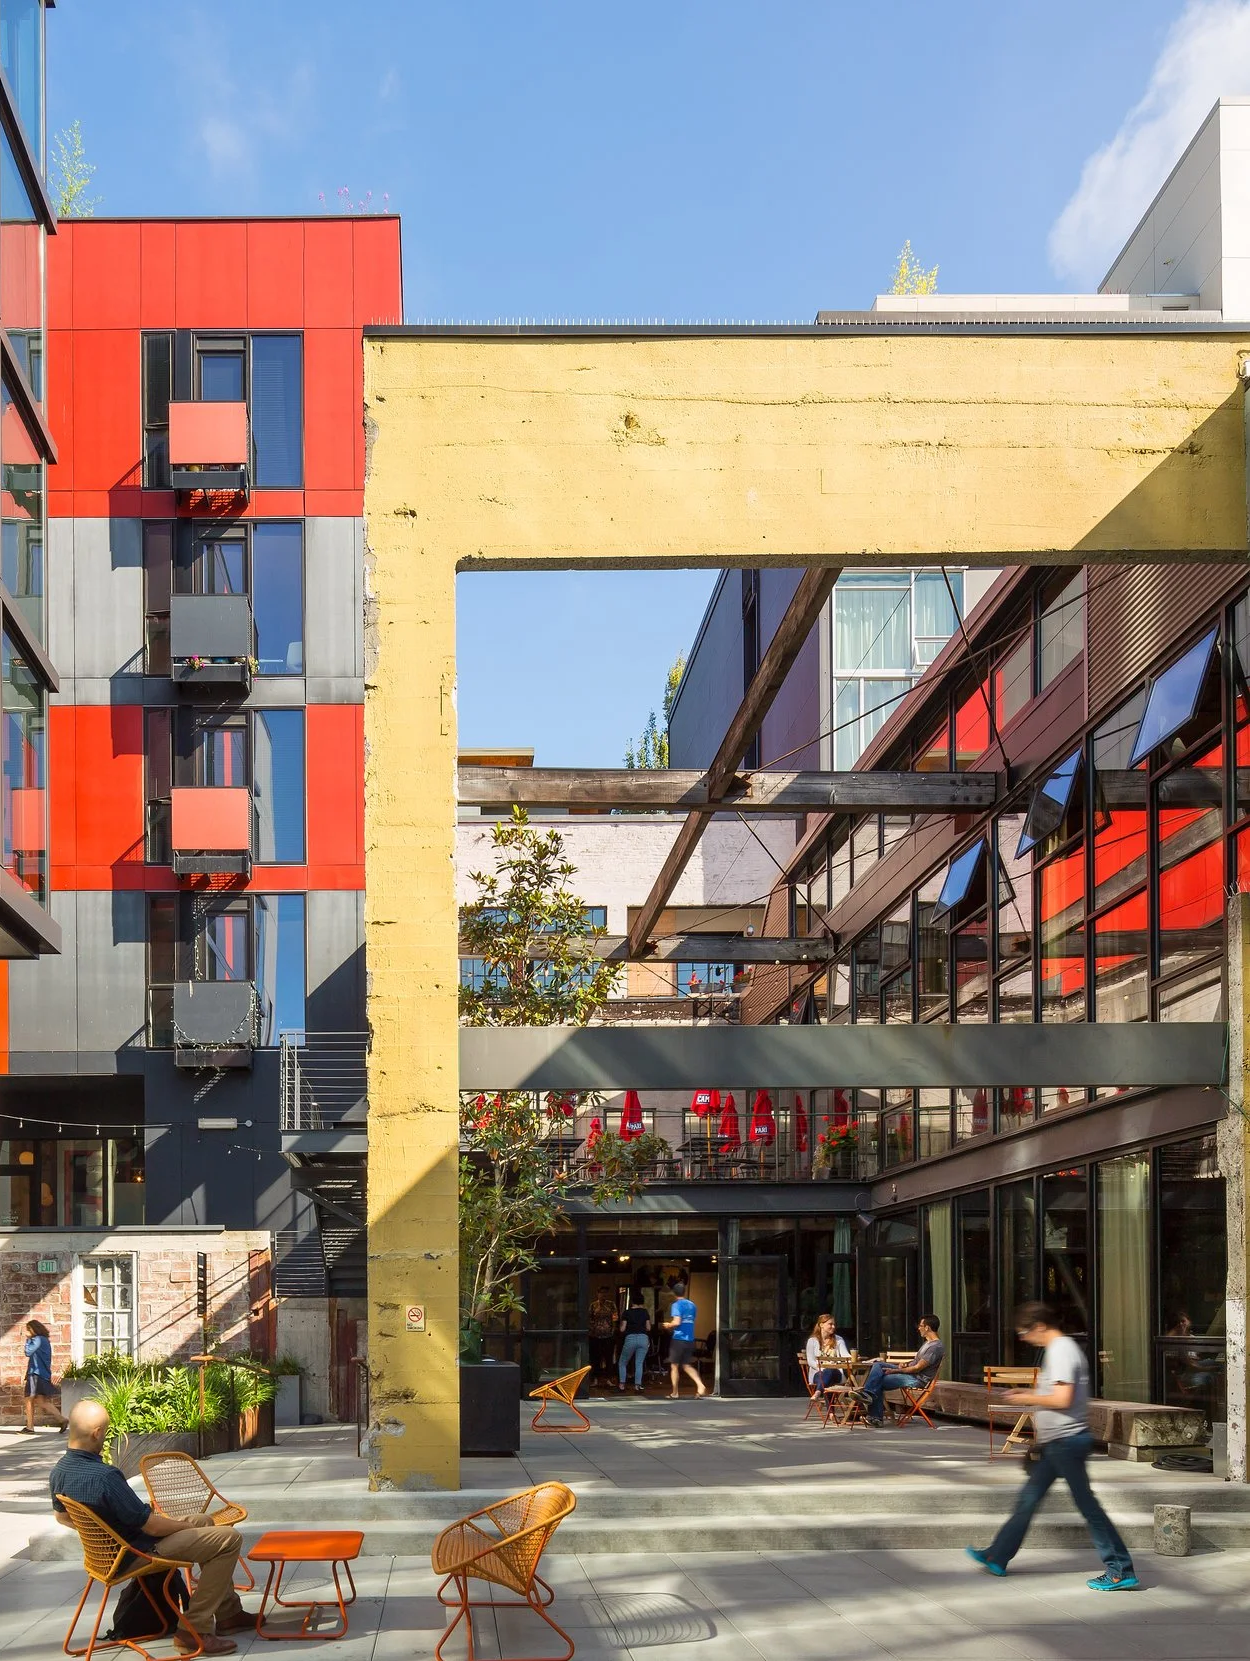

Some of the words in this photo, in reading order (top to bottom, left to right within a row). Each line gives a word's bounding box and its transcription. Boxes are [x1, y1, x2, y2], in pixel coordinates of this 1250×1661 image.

[697, 1095, 710, 1103] CAM
[754, 1125, 768, 1134] PARI
[41, 1261, 55, 1271] EXIT
